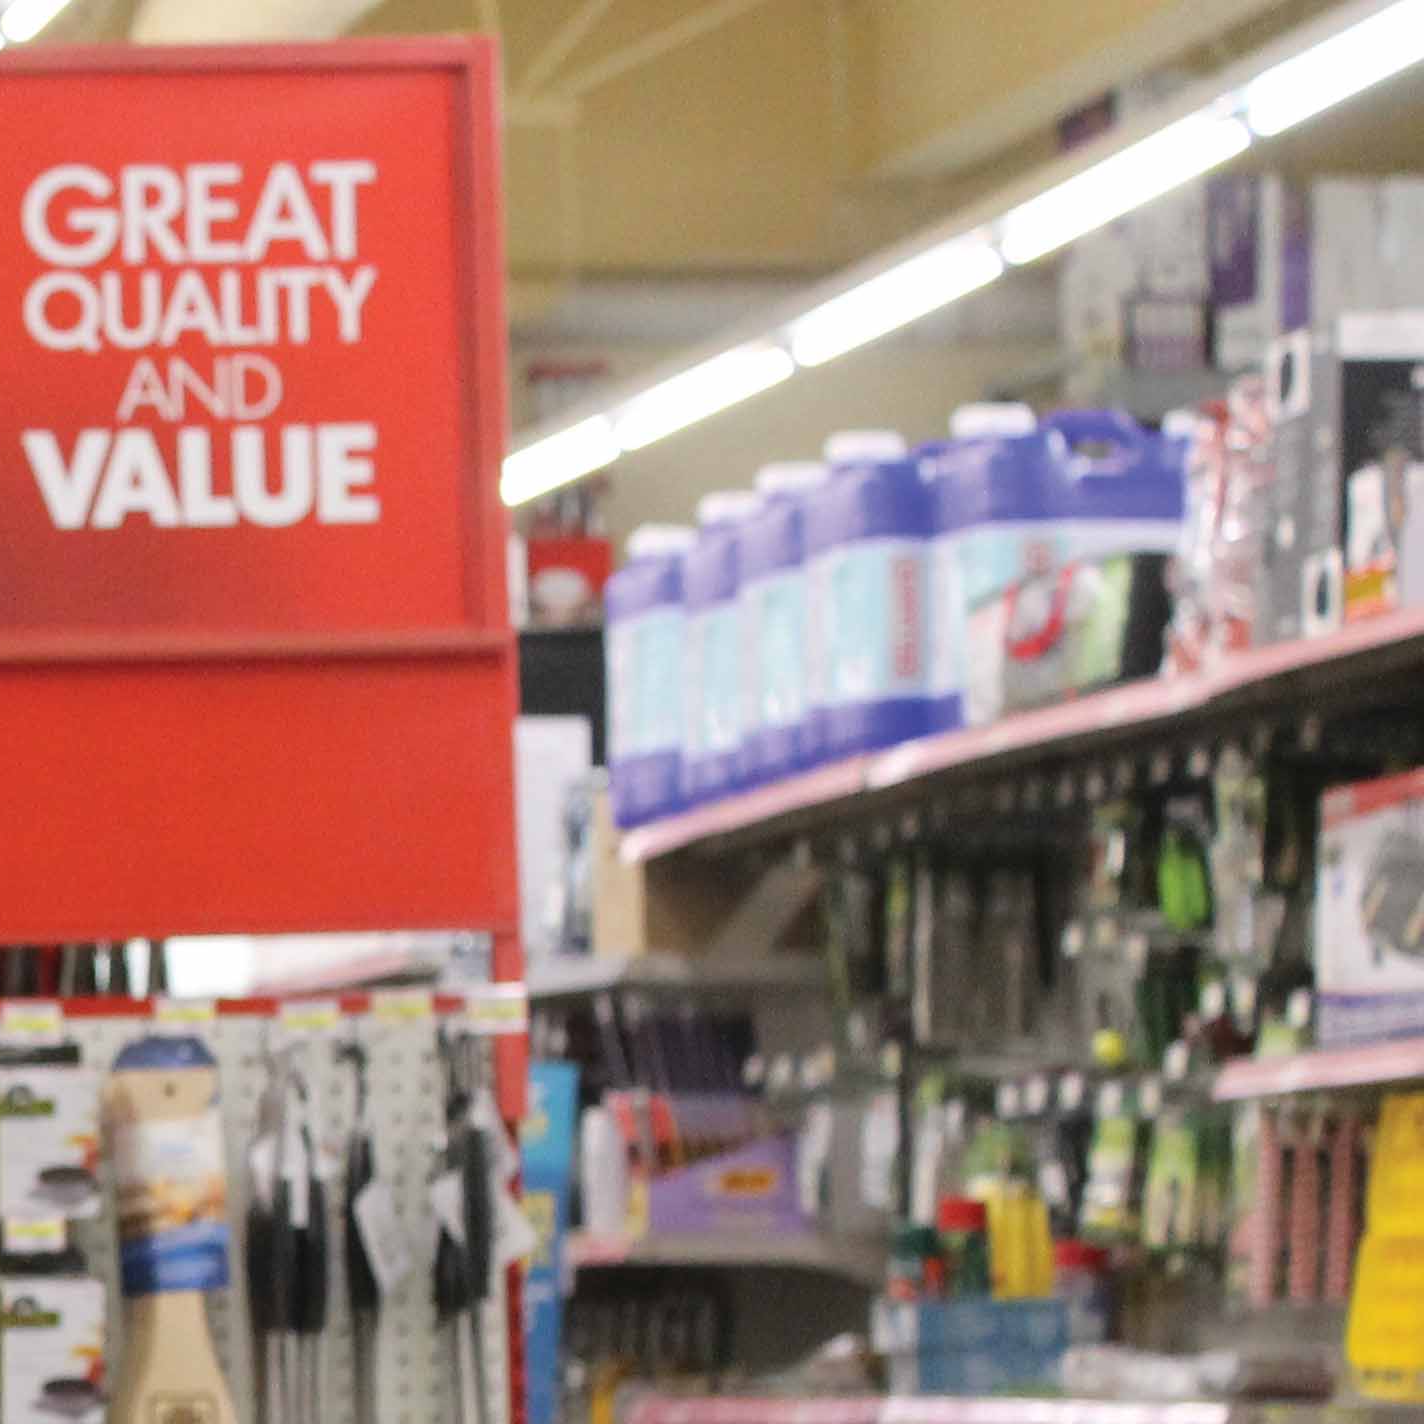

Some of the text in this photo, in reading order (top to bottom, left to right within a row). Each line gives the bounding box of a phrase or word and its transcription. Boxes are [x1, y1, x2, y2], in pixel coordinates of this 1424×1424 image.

[22, 160, 376, 266] GREAT
[23, 265, 377, 352] QUALITY
[116, 354, 283, 422] AND
[22, 424, 380, 530] VALUE
